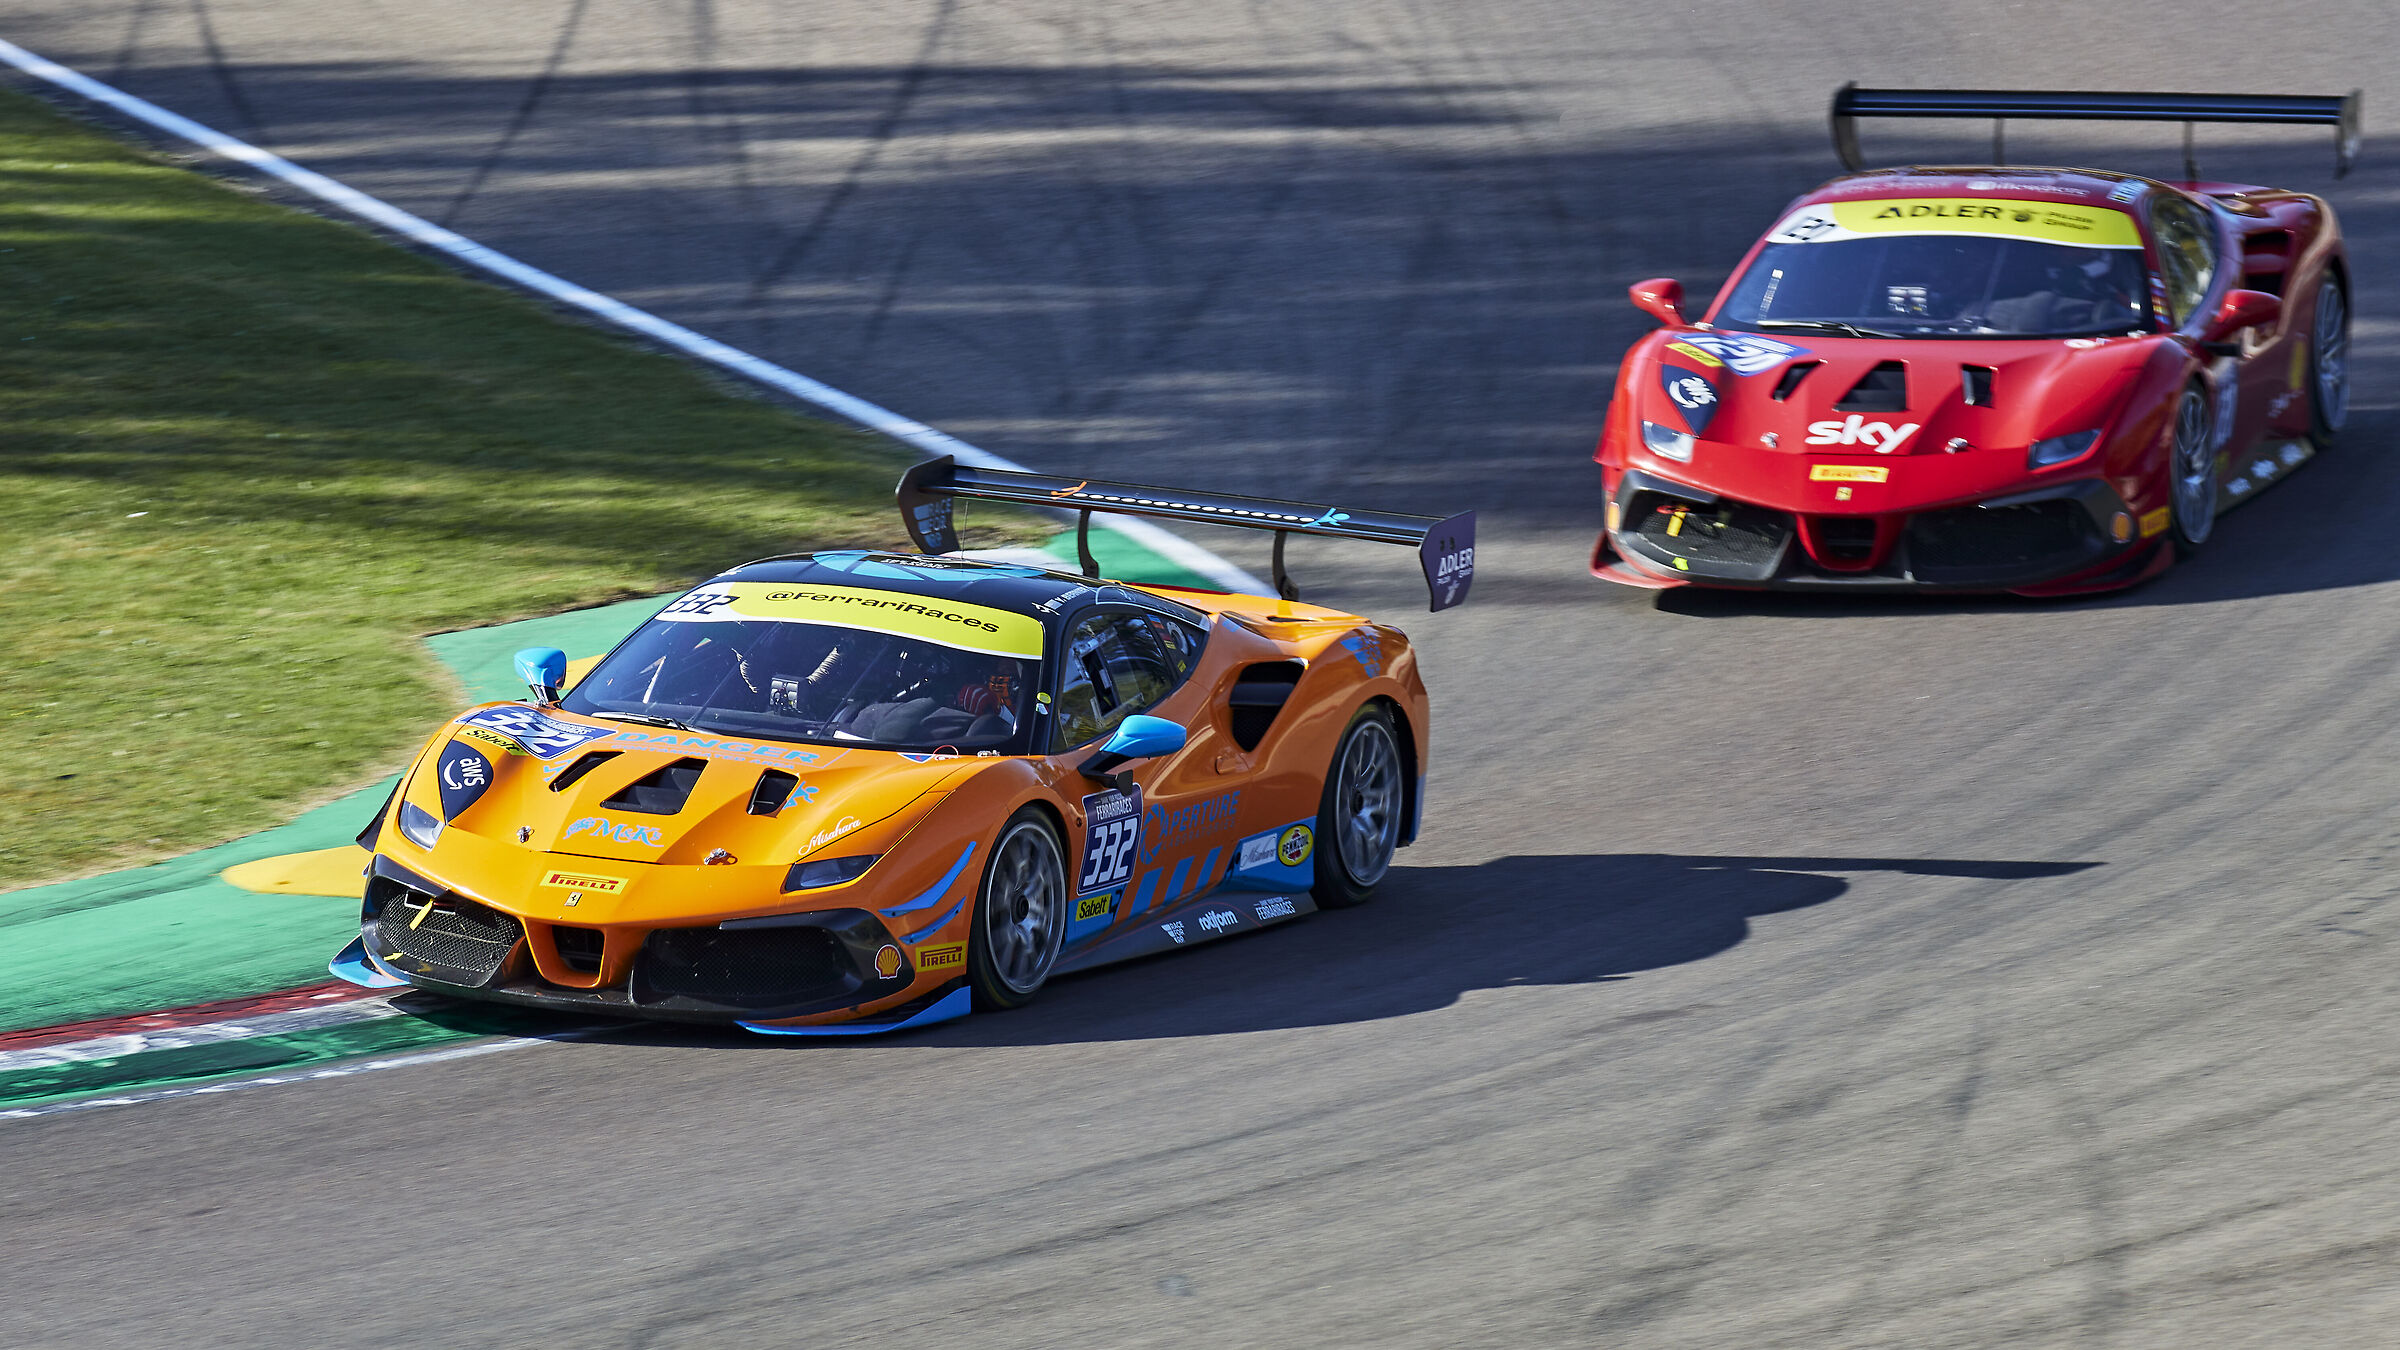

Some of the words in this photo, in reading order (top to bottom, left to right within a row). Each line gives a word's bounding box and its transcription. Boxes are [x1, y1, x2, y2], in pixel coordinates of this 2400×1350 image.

[1874, 204, 2003, 220] ADLER
[1804, 414, 1921, 454] sky
[1437, 547, 1474, 577] ADLER
[663, 594, 740, 614] 332
[766, 590, 1000, 634] @FerrariRaces
[474, 711, 585, 754] 332
[614, 732, 821, 763] DANGER
[459, 757, 485, 787] aws
[611, 745, 746, 762] CONTAMINATED
[749, 758, 795, 770] AREA
[1159, 790, 1240, 839] APERTURE
[798, 815, 861, 856] Misahara
[1083, 817, 1138, 887] 332
[549, 873, 619, 891] PIRELLI
[1080, 897, 1107, 919] Sabelt
[920, 946, 963, 968] PIRELLI
